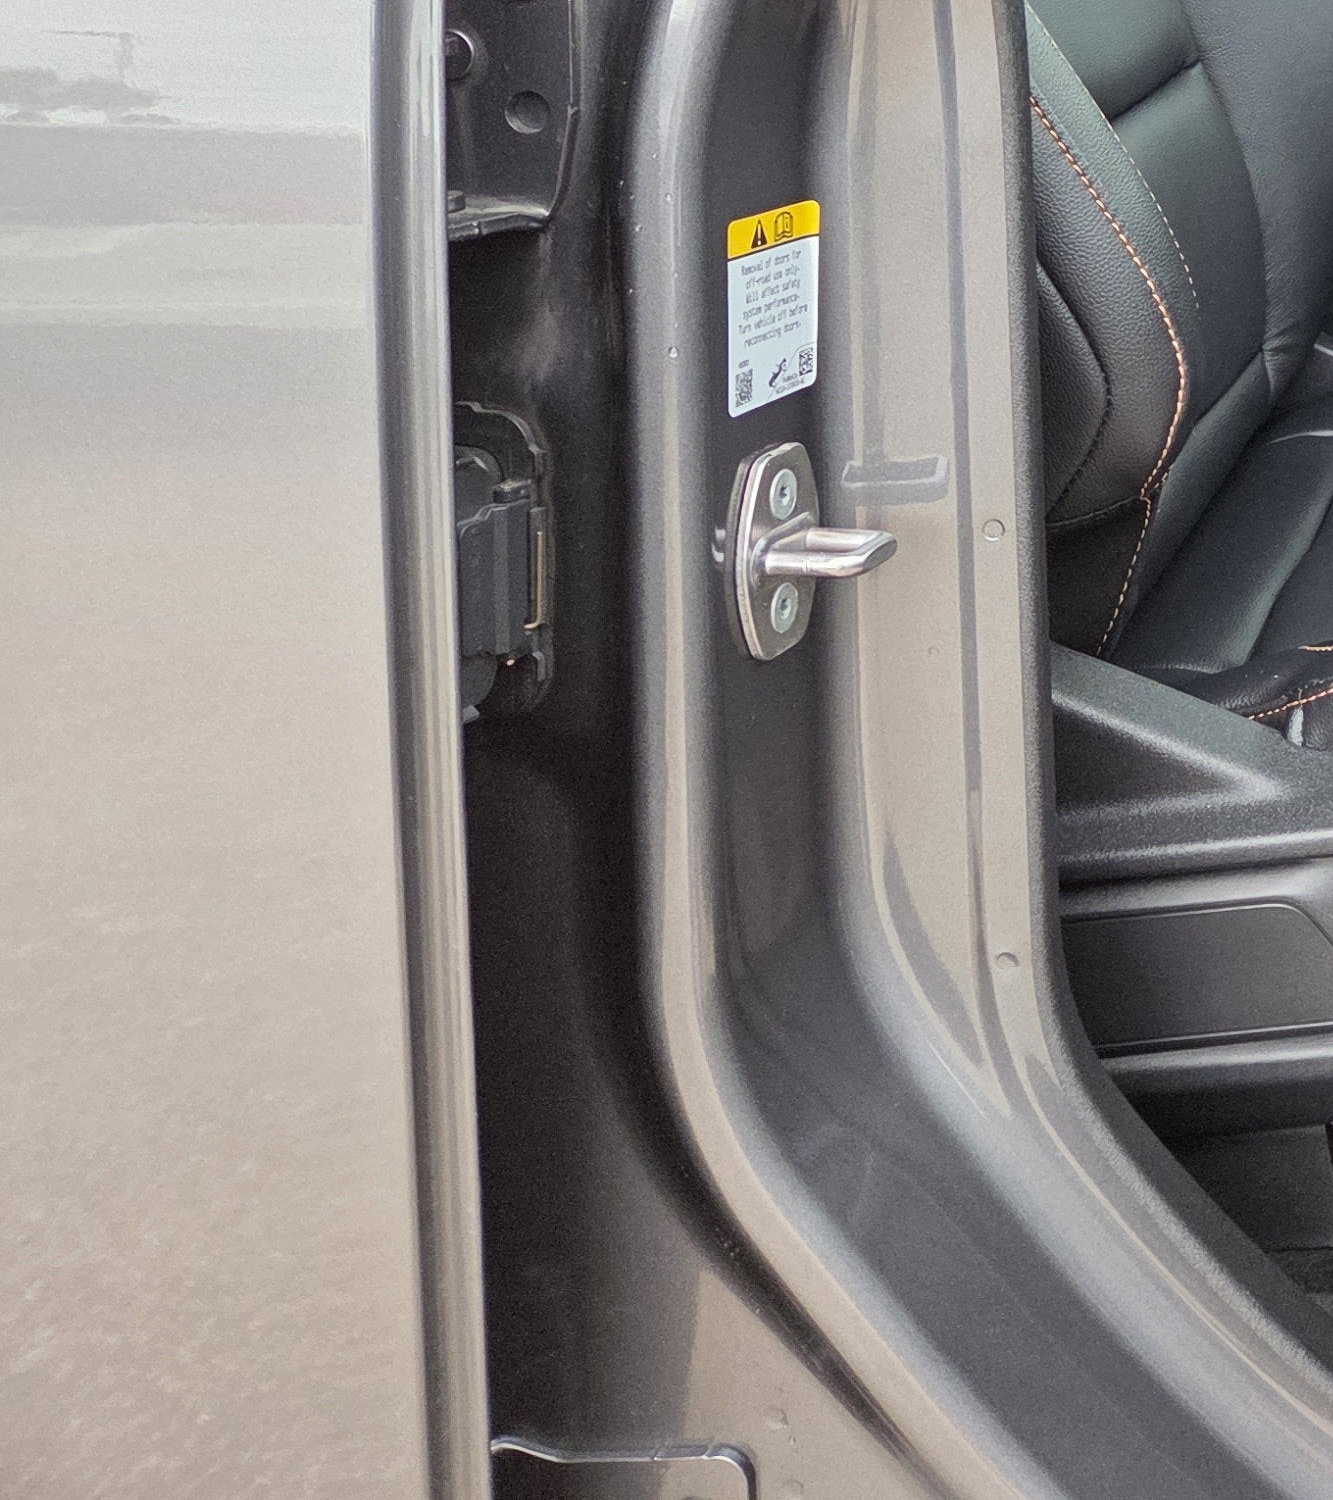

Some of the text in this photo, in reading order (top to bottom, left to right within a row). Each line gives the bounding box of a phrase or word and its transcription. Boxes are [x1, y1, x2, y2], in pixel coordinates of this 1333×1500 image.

[741, 250, 802, 276] Removal of doors for
